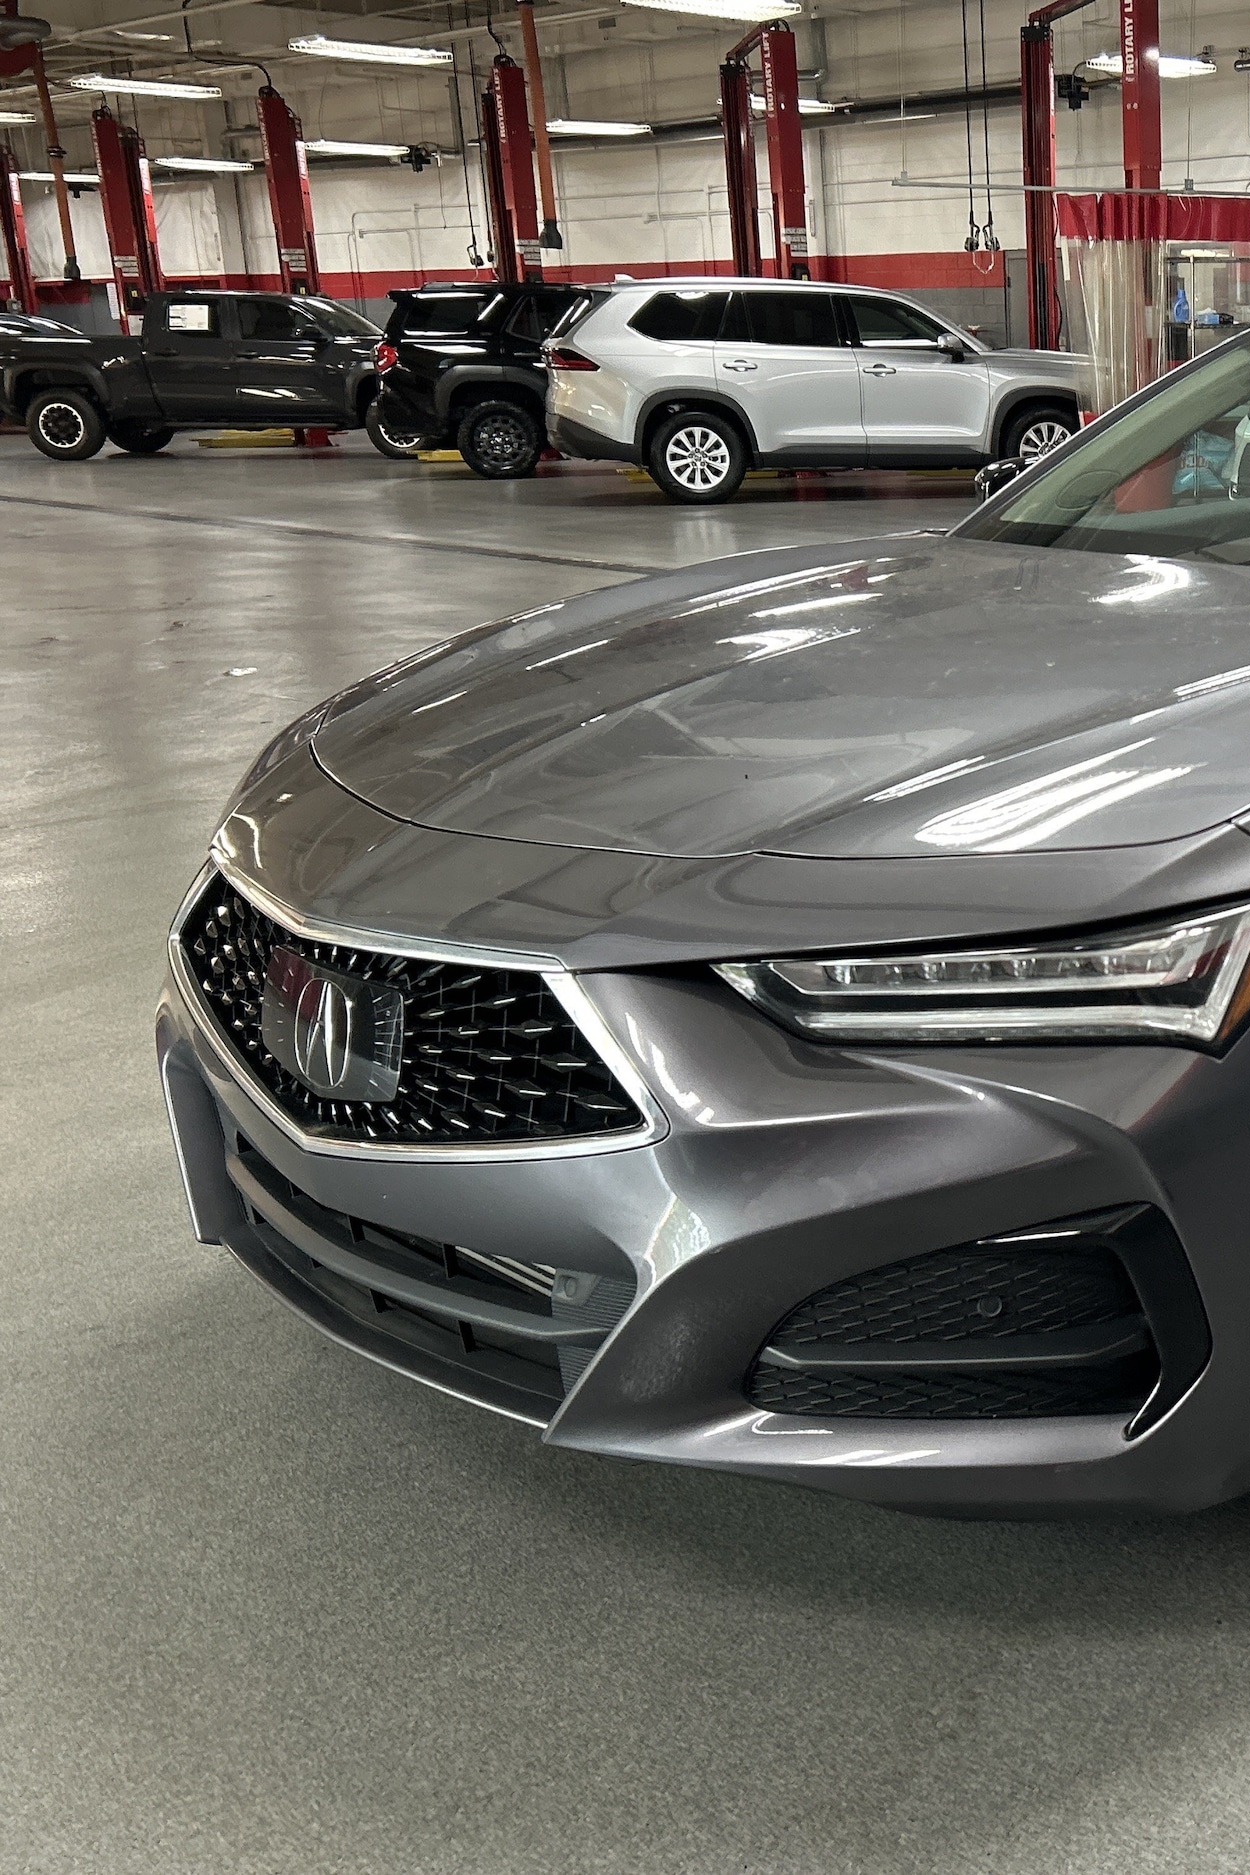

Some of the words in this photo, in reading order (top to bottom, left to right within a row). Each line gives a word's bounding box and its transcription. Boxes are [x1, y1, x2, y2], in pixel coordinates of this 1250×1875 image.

[1124, 0, 1133, 13] LI
[761, 31, 771, 58] LIFT
[1124, 17, 1135, 75] ROTARY
[764, 61, 774, 112] ROTARY
[495, 93, 506, 138] ROTARY
